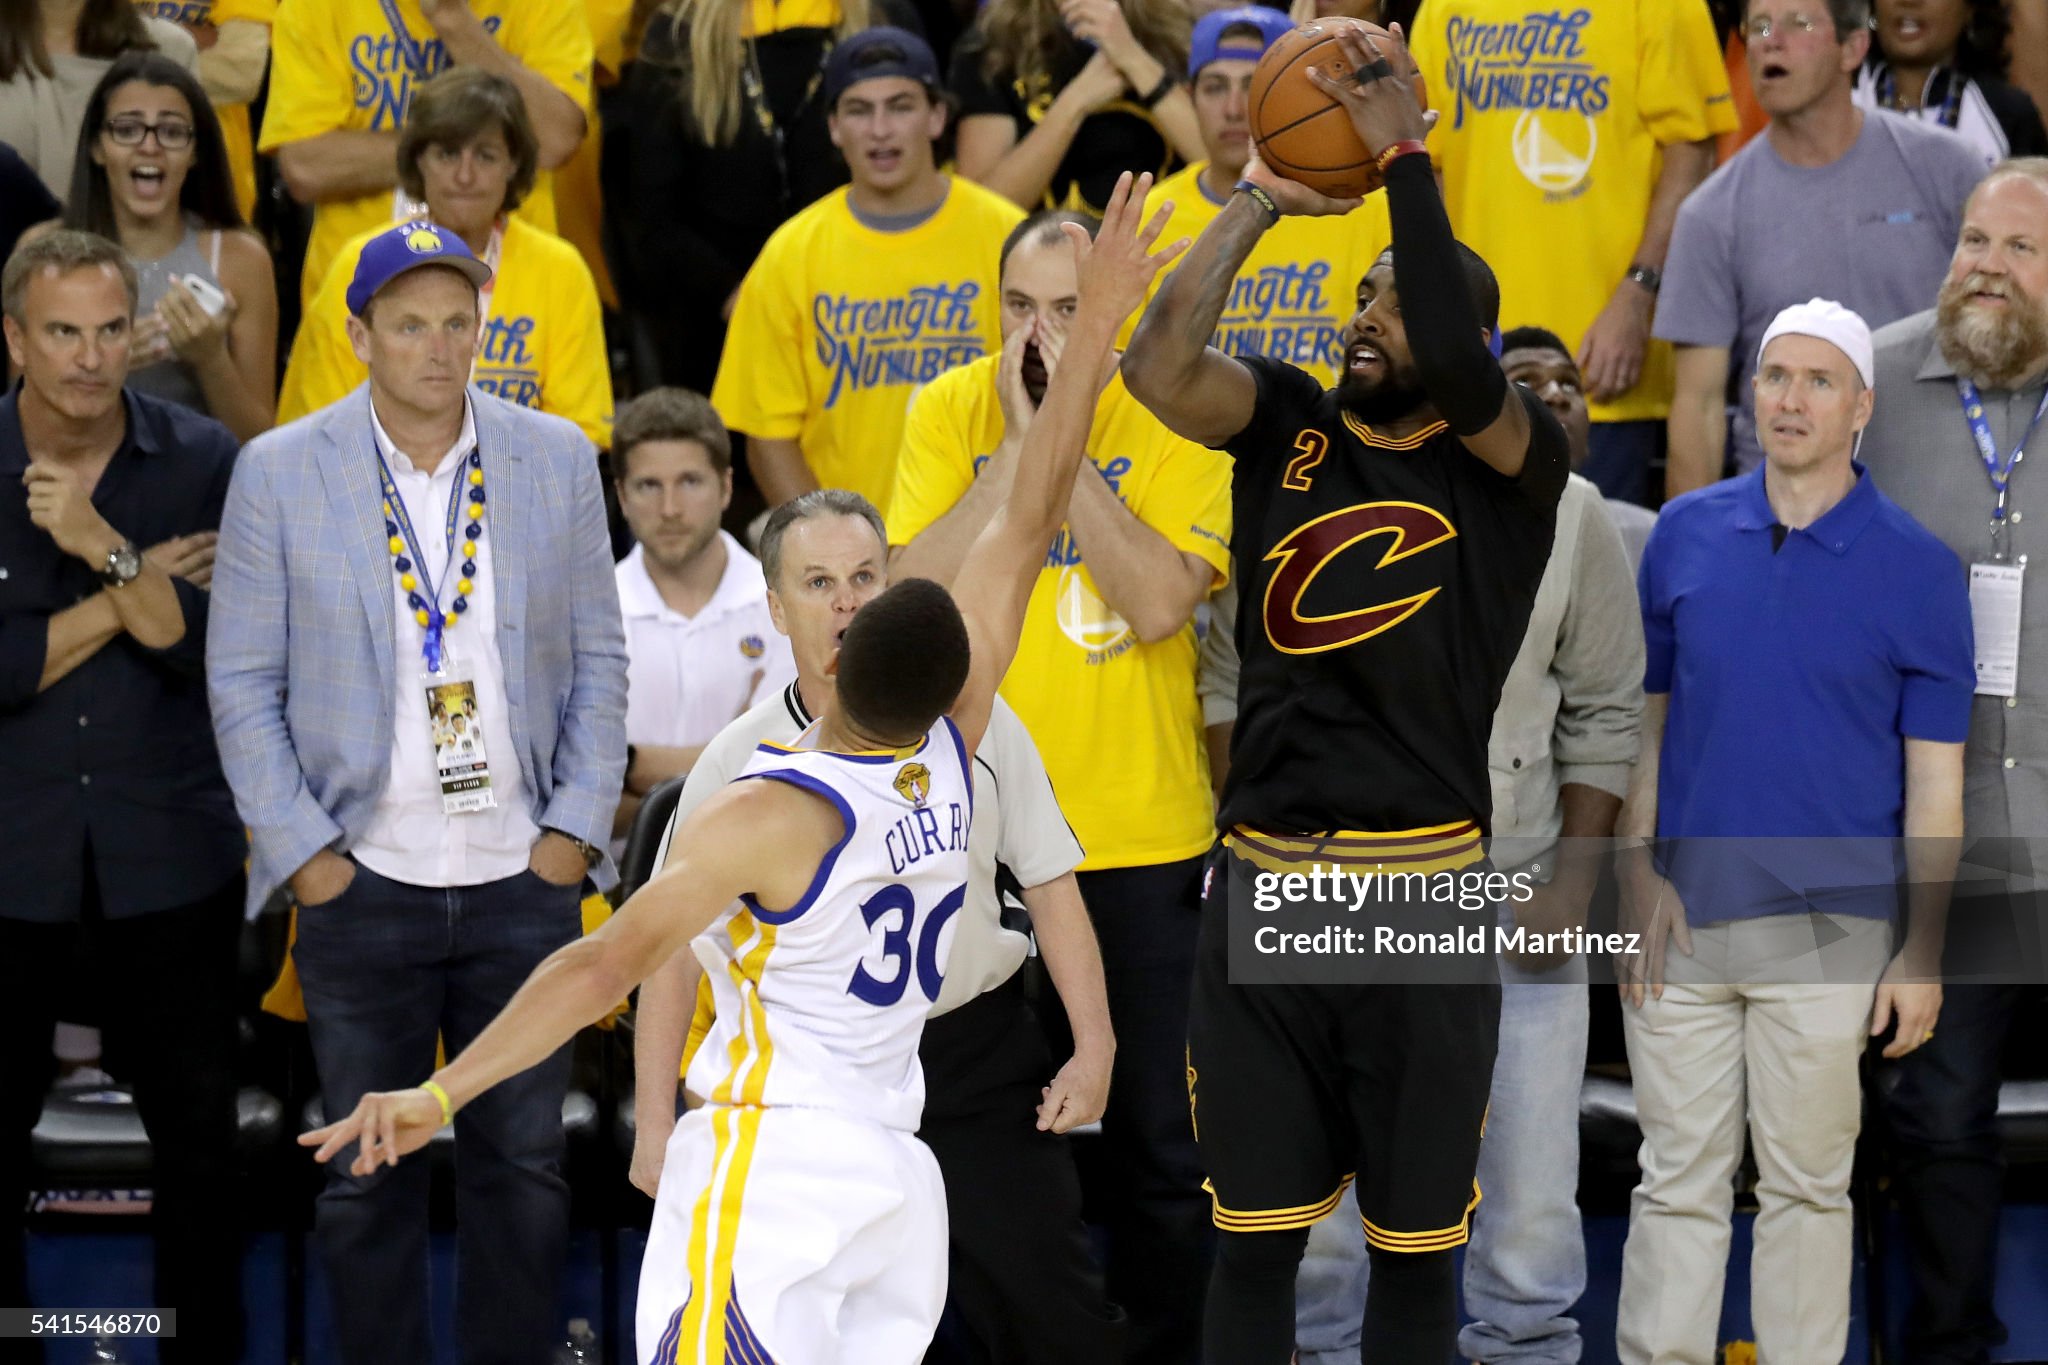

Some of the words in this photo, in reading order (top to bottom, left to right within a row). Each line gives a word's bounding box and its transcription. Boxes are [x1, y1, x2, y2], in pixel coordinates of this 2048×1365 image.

[1446, 9, 1592, 91] Strength
[814, 280, 981, 369] Strength
[1230, 260, 1331, 322] ngth
[1281, 428, 1329, 492] 2
[846, 881, 968, 1008] 30
